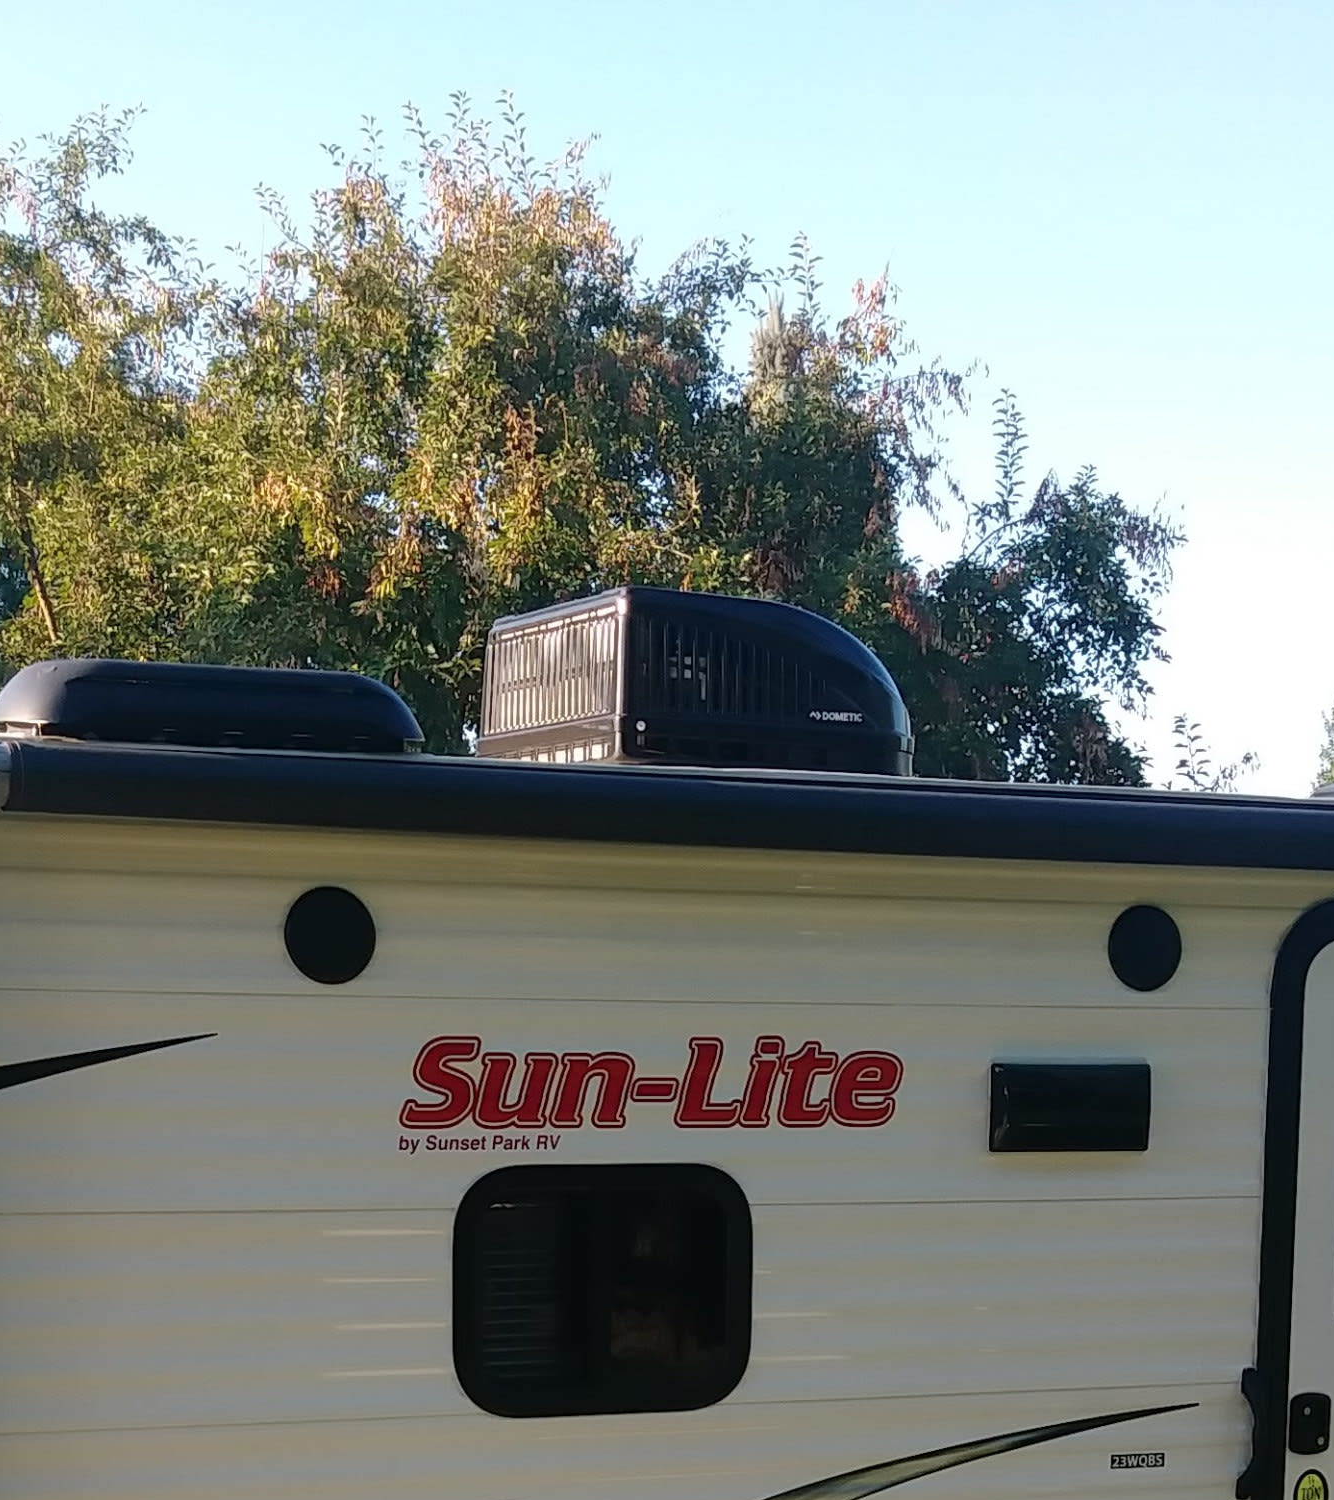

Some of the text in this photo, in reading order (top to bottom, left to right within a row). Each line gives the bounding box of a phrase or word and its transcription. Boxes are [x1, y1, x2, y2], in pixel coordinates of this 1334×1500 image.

[822, 711, 863, 722] DOMETIC
[398, 1035, 904, 1129] Sun-Lite
[398, 1135, 561, 1154] by Sunset Park RV
[1112, 1454, 1163, 1468] 23WQBS
